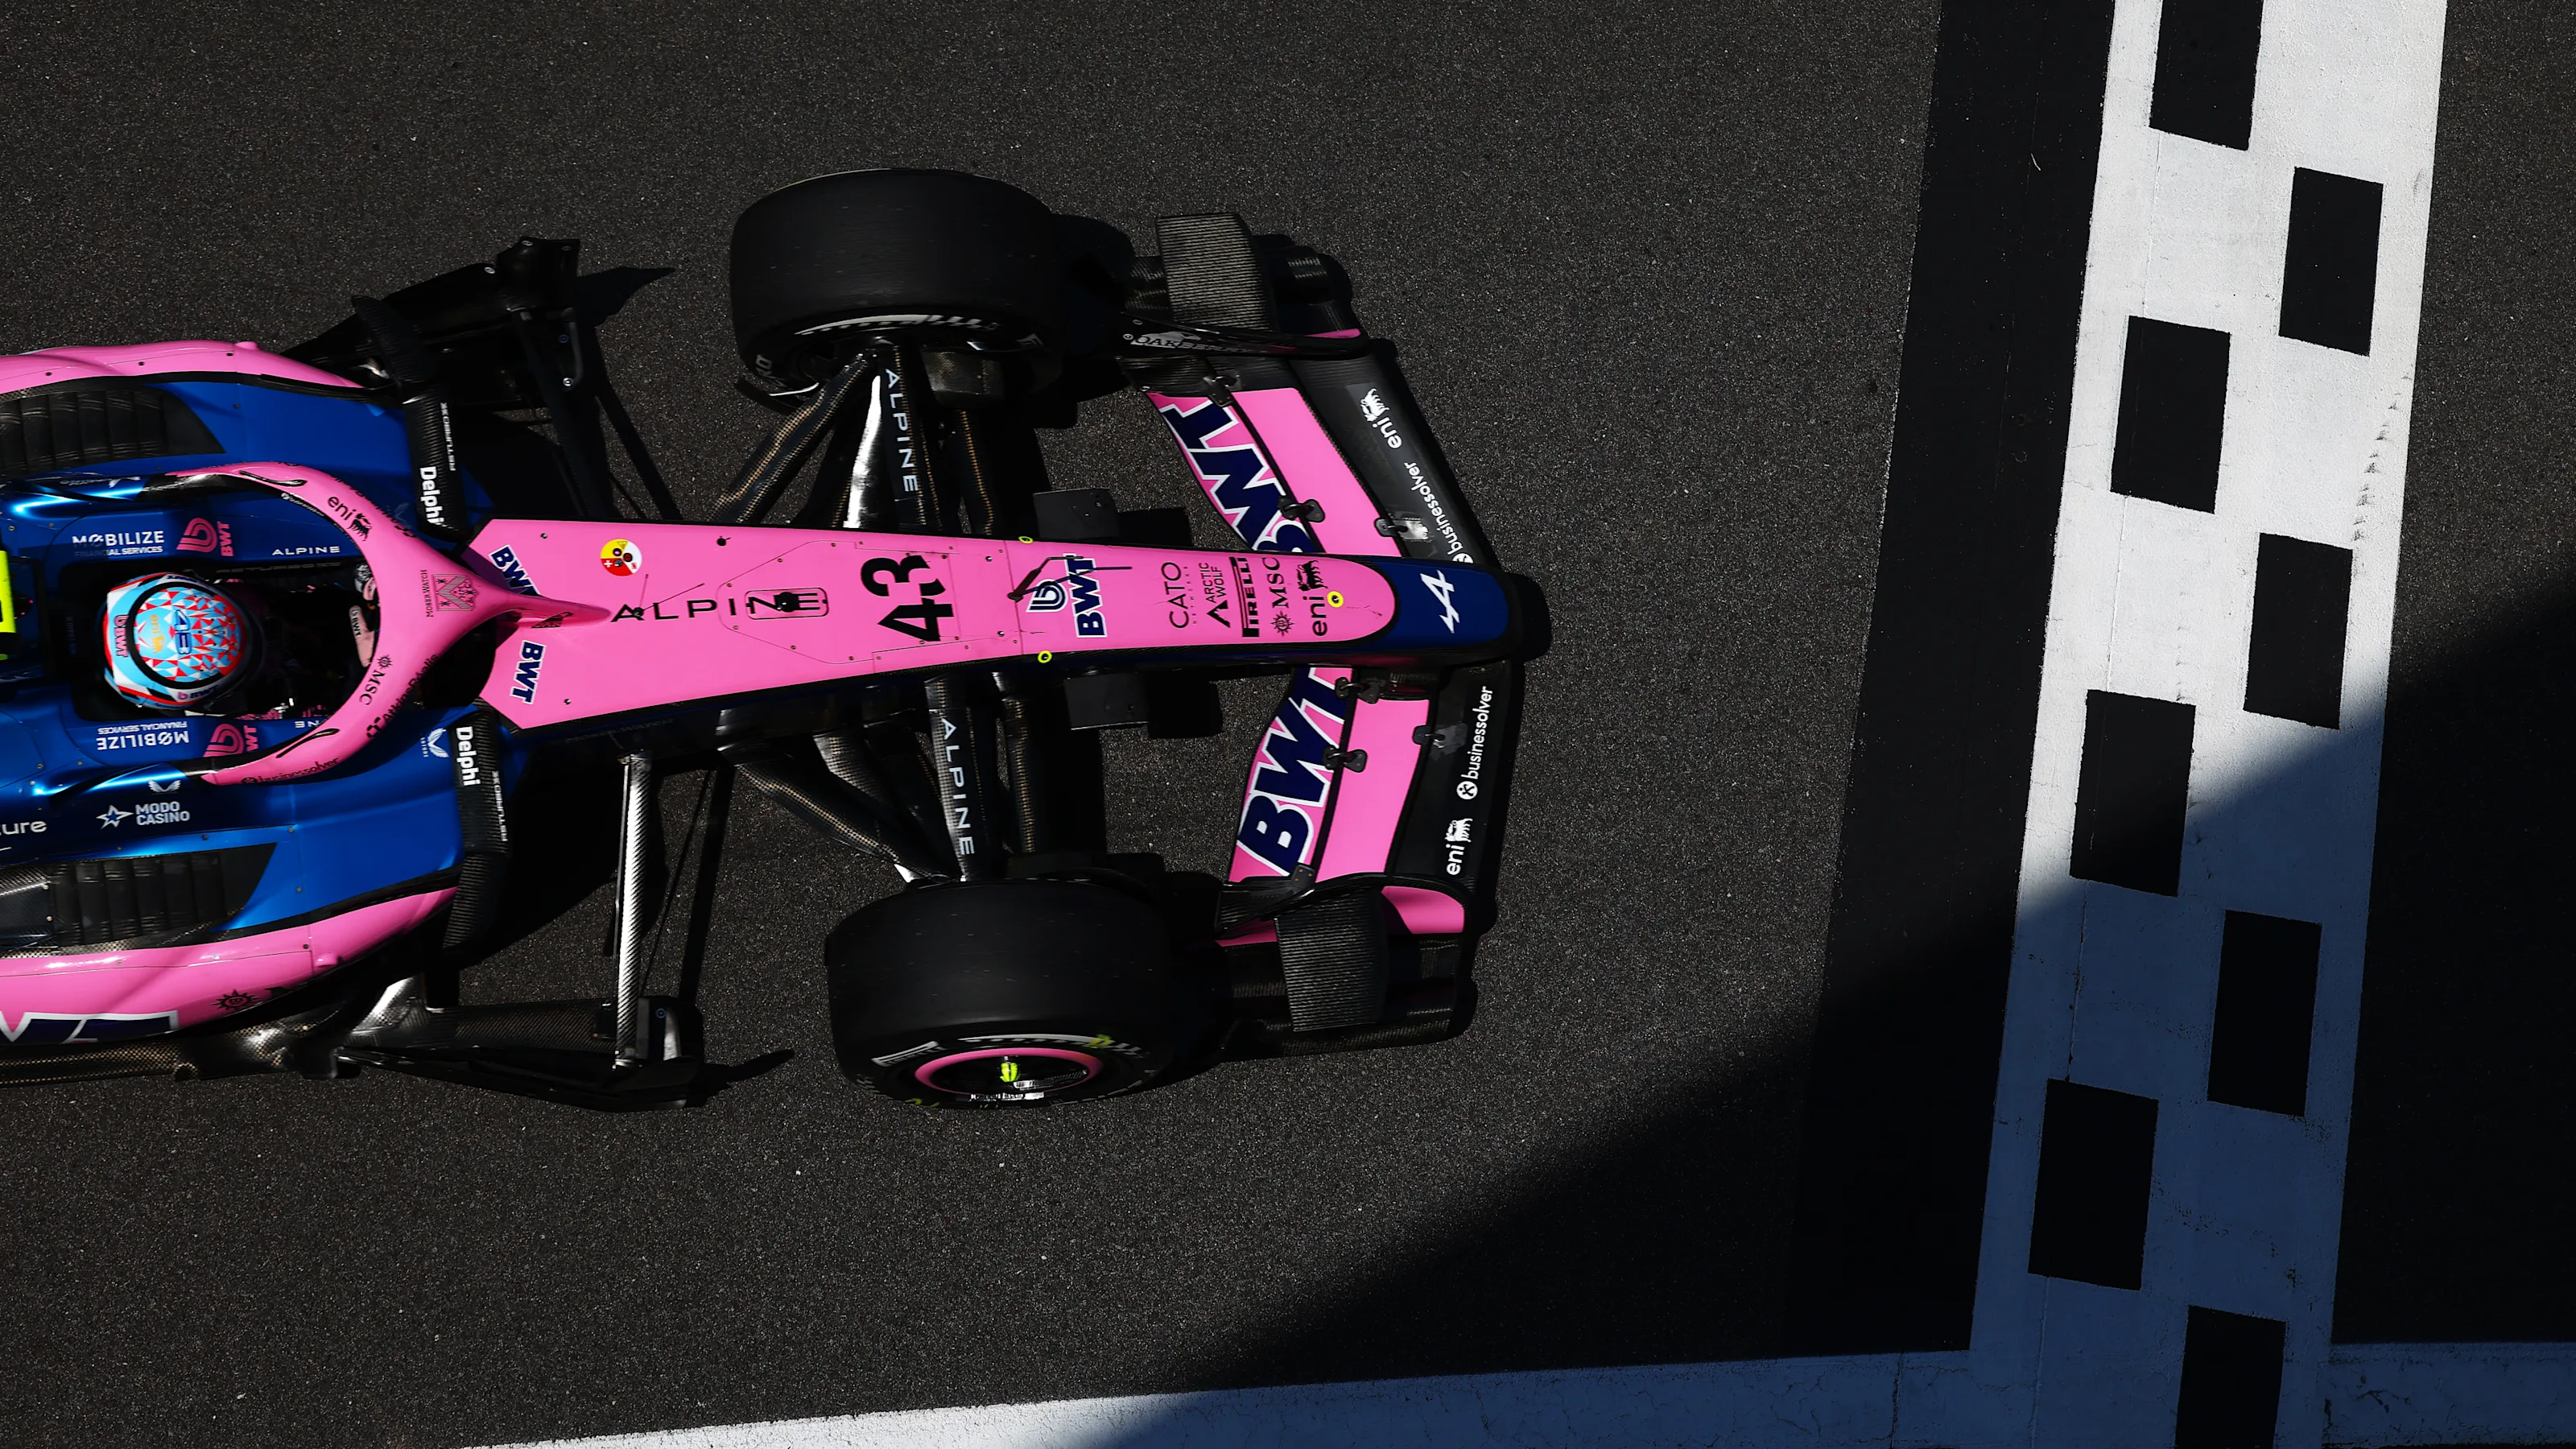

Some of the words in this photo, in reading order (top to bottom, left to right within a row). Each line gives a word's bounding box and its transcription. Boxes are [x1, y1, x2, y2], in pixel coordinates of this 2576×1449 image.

[886, 369, 919, 491] ALPINE
[1373, 417, 1402, 448] eni
[328, 496, 357, 521] eni
[419, 466, 445, 526] Delphi
[1404, 462, 1463, 555] businessolver
[122, 546, 163, 555] SERVICES
[217, 521, 234, 557] BWT
[272, 546, 341, 556] ALPINE
[861, 555, 954, 642] 43
[1063, 553, 1108, 638] BWT
[1161, 562, 1189, 628] CATO
[1183, 567, 1197, 625] NETWORKS
[1199, 563, 1216, 604] ARCTIC
[1211, 566, 1227, 597] WOLF
[1229, 556, 1259, 638] PIRELLI
[1262, 557, 1290, 609] MSC
[610, 592, 821, 623] ALPINE
[1302, 596, 1328, 636] eni
[114, 627, 129, 658] BWT
[359, 670, 386, 705] MSC
[510, 640, 547, 705] BWT
[97, 724, 142, 734] SERVICES
[244, 725, 259, 752] WT
[1461, 686, 1493, 780] businessolver
[258, 757, 340, 782] businessolver
[456, 726, 481, 786] Delphi
[940, 717, 975, 856] ALPINE
[135, 801, 180, 815] MODO
[136, 811, 191, 826] CASINO
[0, 820, 47, 835] ure
[1446, 844, 1465, 875] eni
